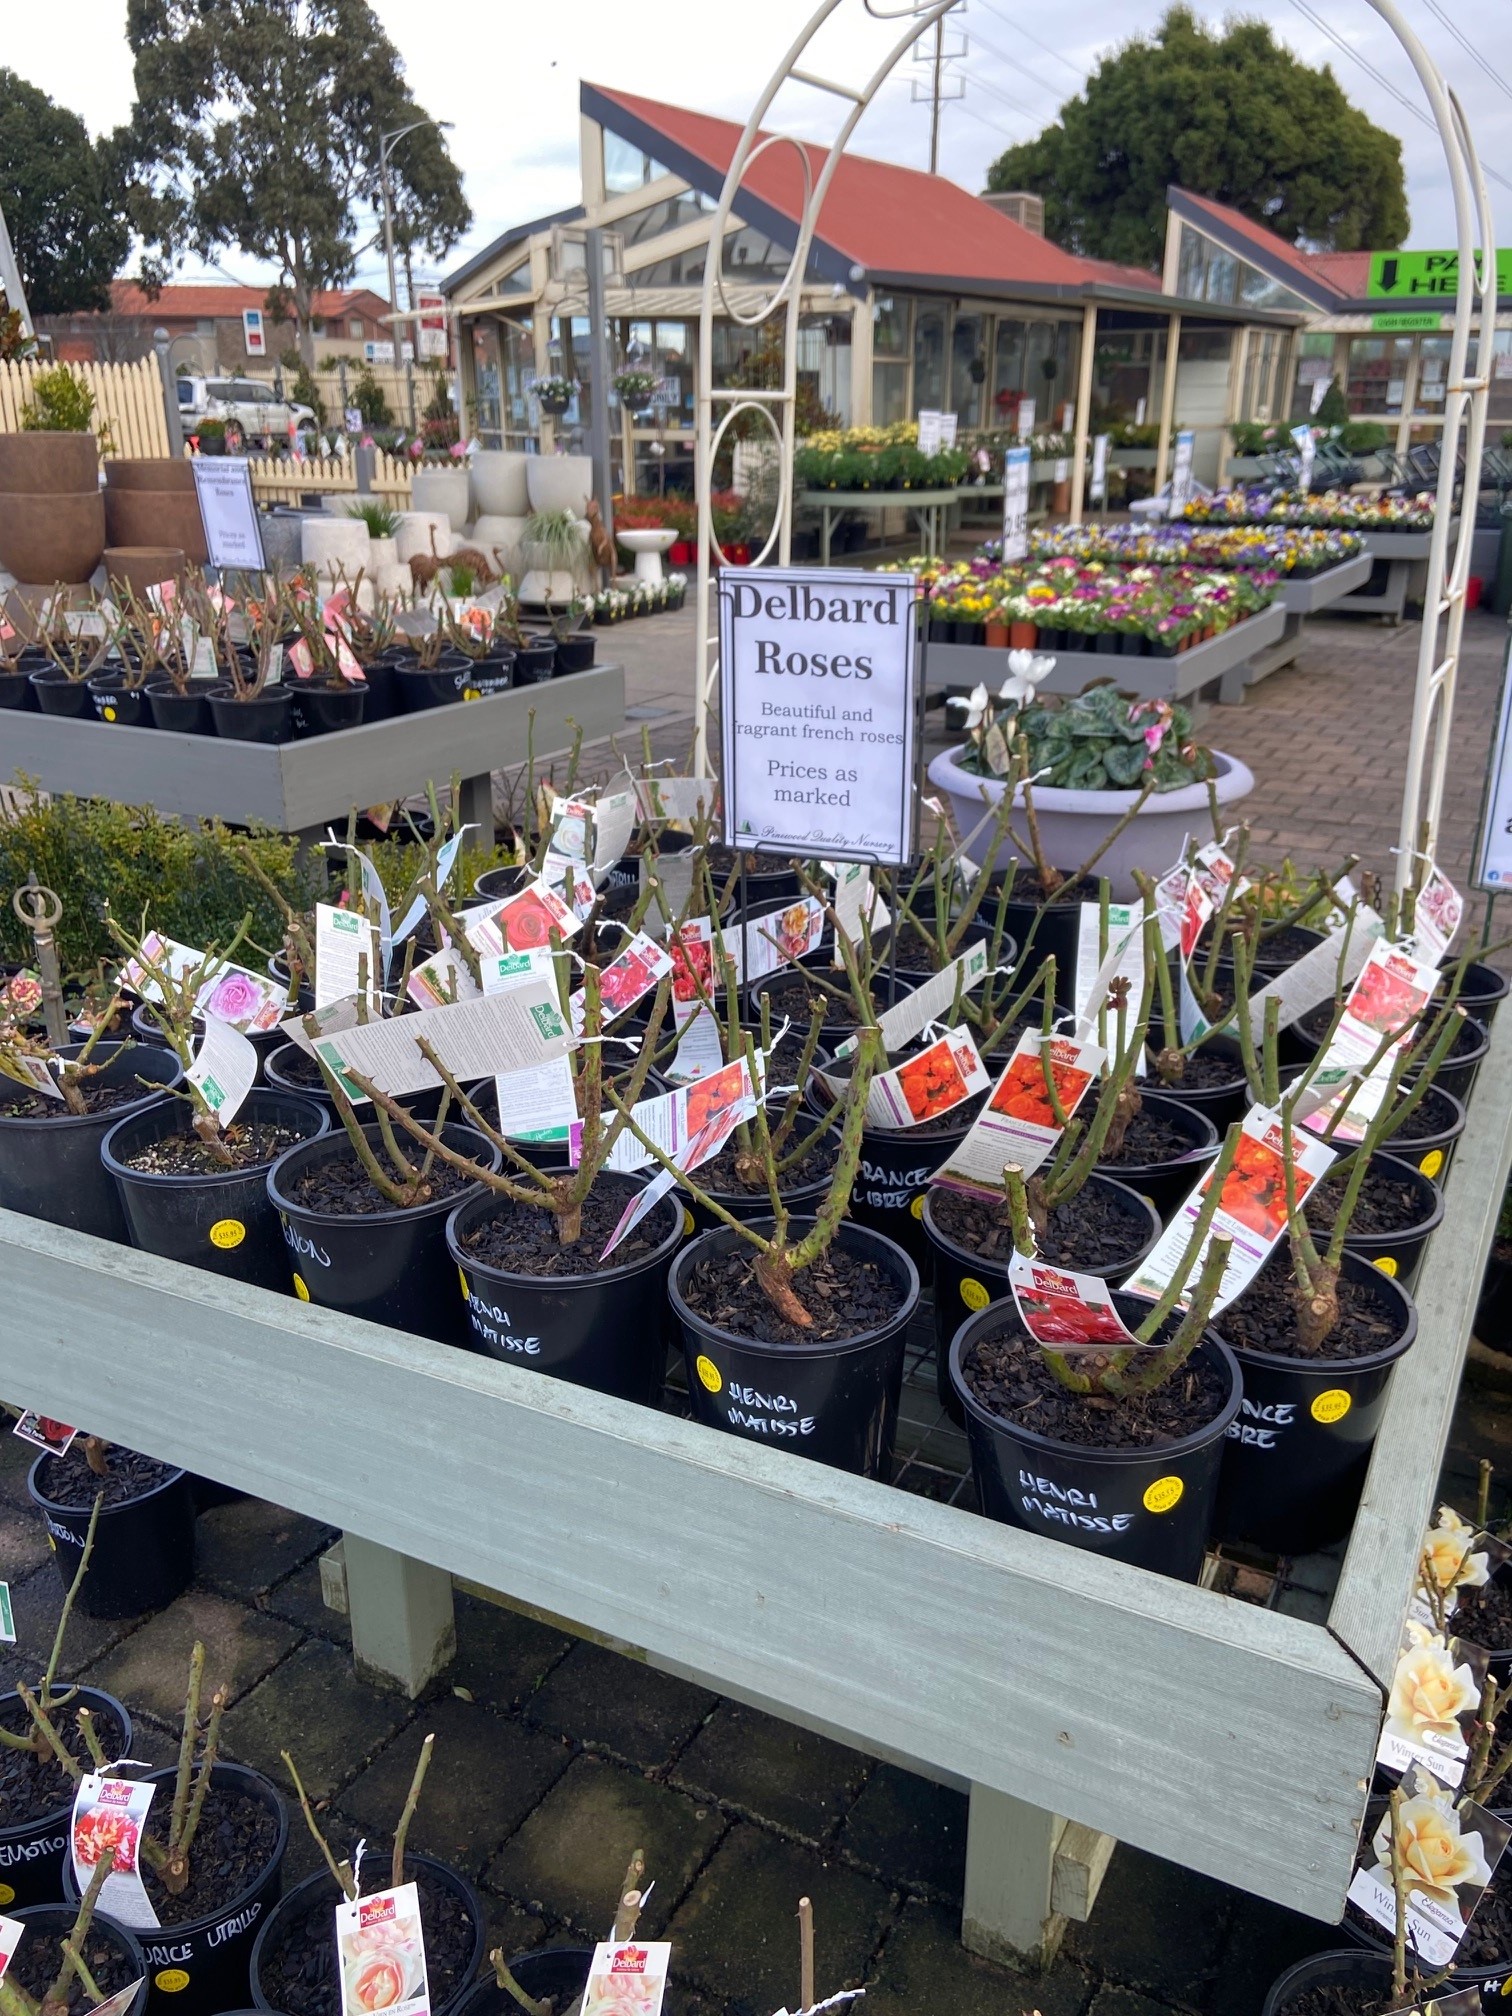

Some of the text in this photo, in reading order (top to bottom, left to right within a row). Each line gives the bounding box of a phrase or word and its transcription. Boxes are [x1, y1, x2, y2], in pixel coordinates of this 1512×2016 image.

[1411, 275, 1506, 292] HEE
[731, 584, 899, 625] Delbard
[755, 640, 873, 680] Roses
[761, 702, 873, 722] Beautiful and
[802, 724, 854, 741] french
[860, 731, 905, 745] roses
[767, 760, 858, 782] Prices as
[774, 788, 851, 807] marked
[760, 826, 895, 851] Pinewood Quality Nursery
[500, 960, 531, 974] Delbard
[534, 1005, 558, 1038] Delbard
[956, 1049, 972, 1076] Delbard
[1048, 1047, 1078, 1062] elbard
[1264, 1130, 1302, 1159] Delrd
[861, 1160, 932, 1186] RANCE
[853, 1188, 915, 1209] LIBRE
[1034, 1275, 1078, 1294] Delbard
[471, 1314, 540, 1355] MATISSE
[728, 1382, 798, 1413] HENRI
[727, 1407, 816, 1437] MATISSE
[1241, 1398, 1298, 1425] NCE
[1225, 1420, 1284, 1449] BRE
[1019, 1469, 1098, 1509] HENRI
[1021, 1495, 1136, 1533] MATISSE
[1413, 1605, 1429, 1620] Sun
[1390, 1739, 1445, 1773] Winter Sun
[100, 1789, 130, 1801] Delbard
[0, 1834, 70, 1866] EMOTIO
[360, 1906, 395, 1923] Delbard
[1421, 1897, 1454, 1926] Eleganza
[206, 1902, 262, 1948] UTRILLO
[1412, 1919, 1431, 1942] Sun
[141, 1943, 194, 1966] URICE
[613, 1957, 646, 1968] Delbard
